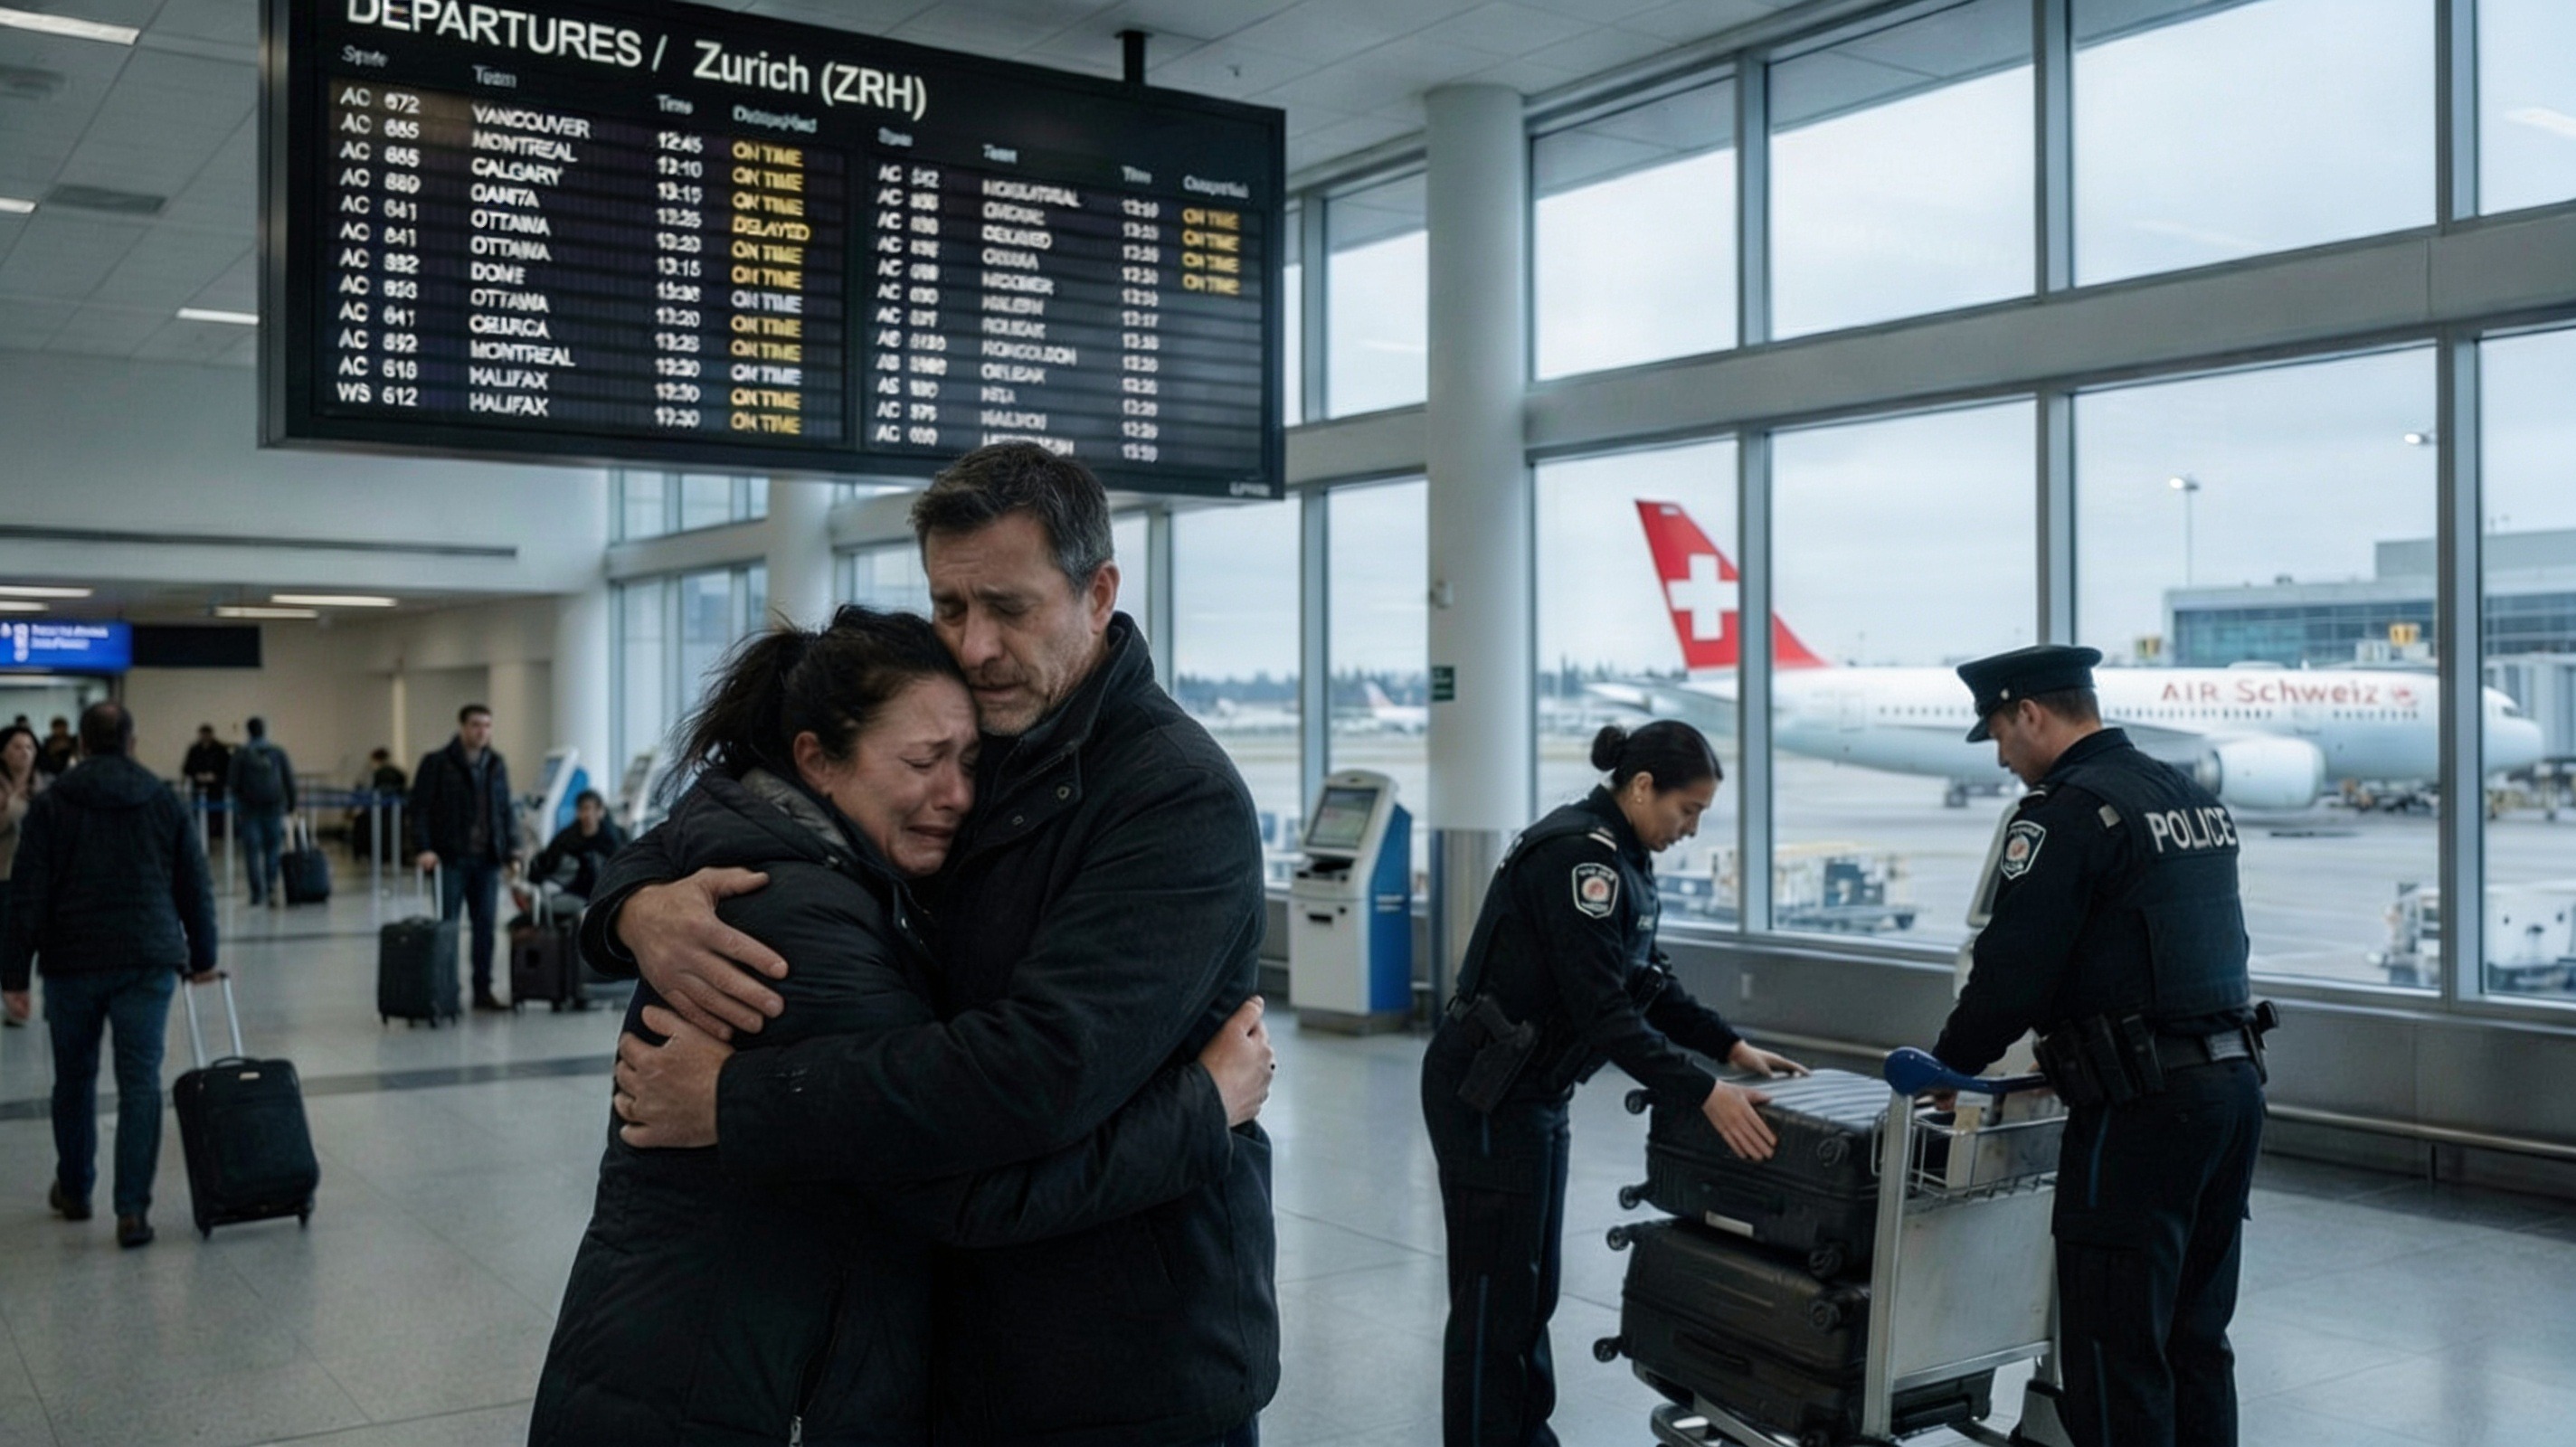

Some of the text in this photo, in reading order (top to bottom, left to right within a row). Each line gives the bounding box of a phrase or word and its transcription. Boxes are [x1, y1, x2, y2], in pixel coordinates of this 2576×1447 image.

[347, 0, 641, 70] DEPARTURES
[651, 35, 668, 71] /
[694, 41, 810, 93] Zurich
[820, 61, 926, 121] (ZRH)
[340, 87, 370, 107] AC
[472, 105, 590, 140] VANCOUVER
[341, 113, 371, 134] AC
[472, 128, 580, 165] MONTREAL
[340, 141, 370, 160] AC
[471, 157, 563, 184] CALGARY
[879, 166, 902, 182] AC
[340, 168, 370, 187] AC
[733, 215, 810, 241] DELAYED
[341, 195, 369, 213] AC
[877, 189, 903, 205] AC
[878, 212, 901, 229] AC
[340, 222, 369, 241] AC
[878, 236, 902, 252] AC
[340, 248, 368, 269] AC
[878, 259, 902, 277] AC
[340, 275, 369, 295] AC
[877, 283, 901, 299] AC
[339, 302, 368, 322] AC
[876, 307, 901, 324] AC
[339, 328, 368, 349] AC
[470, 340, 575, 366] MONTREAL
[339, 356, 367, 375] AC
[469, 366, 548, 390] HALIFAX
[337, 383, 371, 402] WS
[469, 392, 548, 416] HALIFAX
[876, 402, 901, 418] AC
[876, 424, 900, 441] AC
[2161, 678, 2381, 705] AIR Schweiz
[2145, 806, 2238, 853] POLICE
